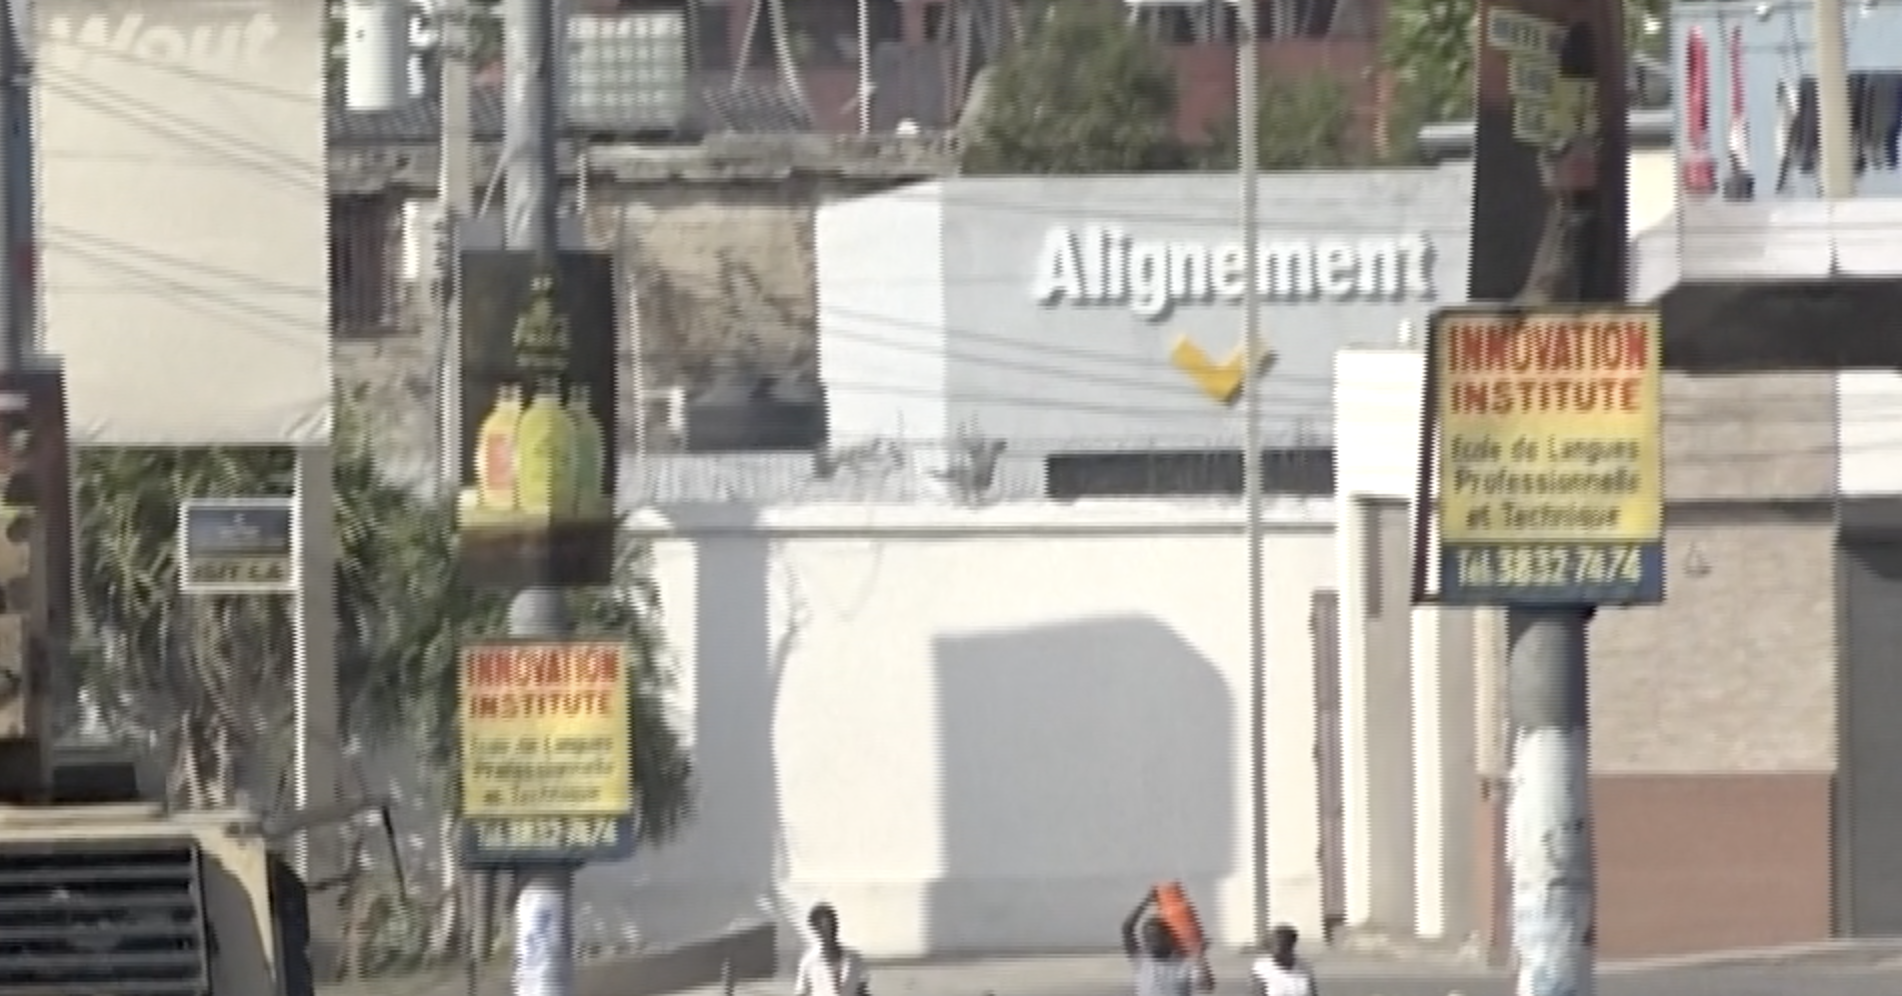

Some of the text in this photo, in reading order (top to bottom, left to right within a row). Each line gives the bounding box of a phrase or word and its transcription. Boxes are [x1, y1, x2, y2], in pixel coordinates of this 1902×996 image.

[1032, 223, 1436, 323] Alignement
[1449, 321, 1649, 375] INNOVATION
[1450, 378, 1641, 415] INSTITUTE
[1510, 436, 1539, 462] de
[467, 649, 620, 687] INNOVATION
[469, 690, 614, 719] INSTITUTE
